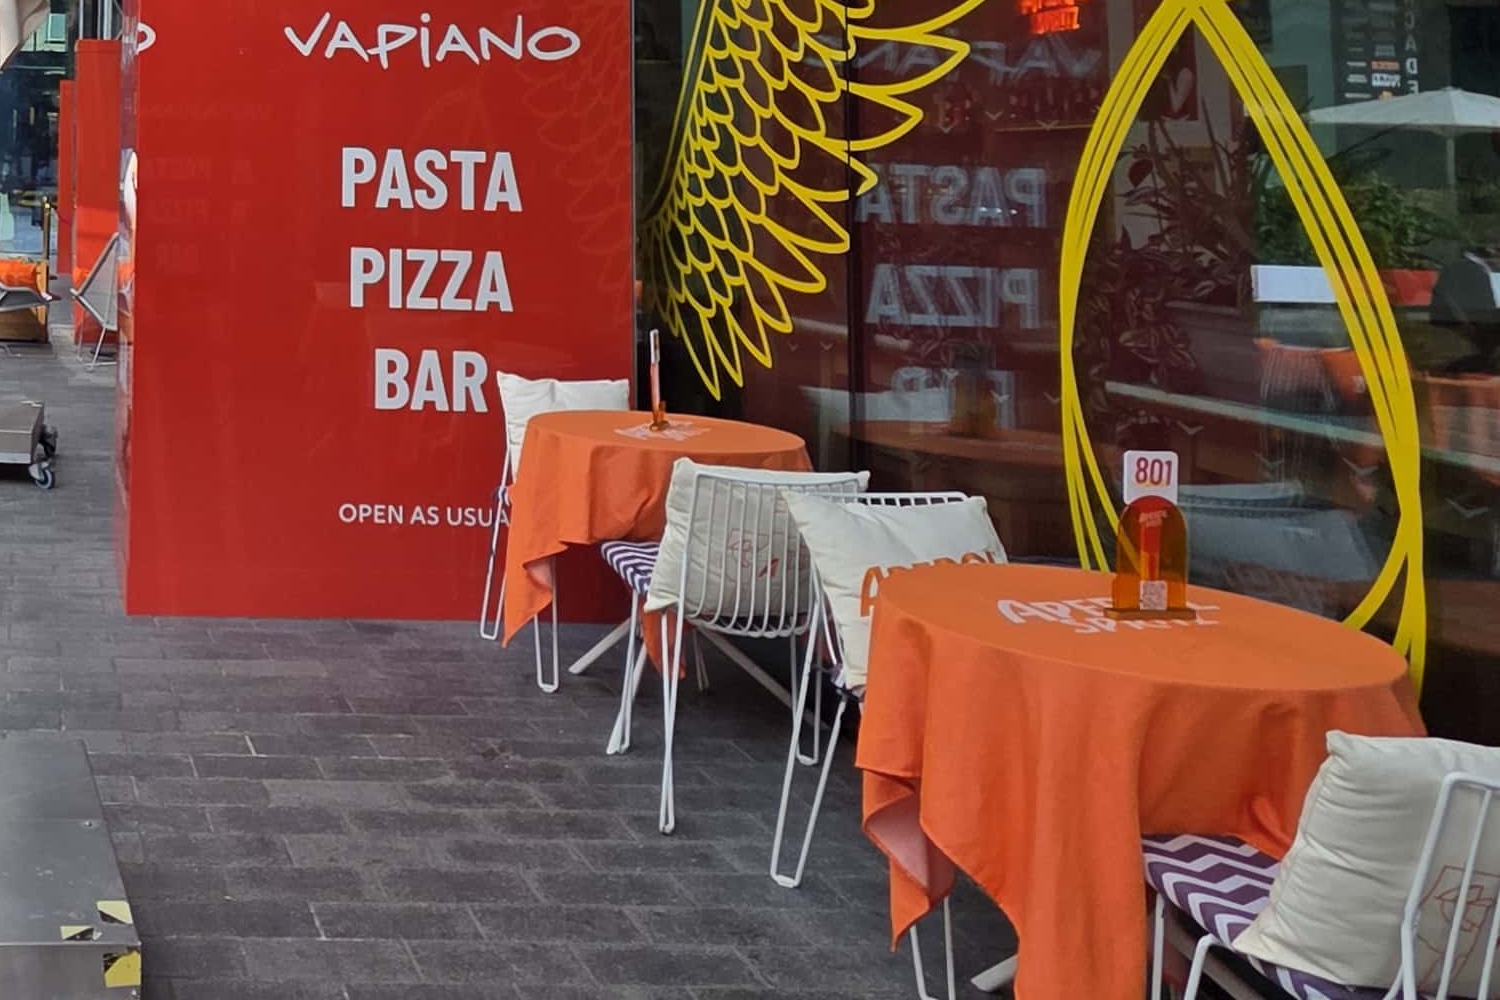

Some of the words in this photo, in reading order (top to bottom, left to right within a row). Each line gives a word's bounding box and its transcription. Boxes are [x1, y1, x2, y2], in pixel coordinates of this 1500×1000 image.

[284, 12, 581, 69] VAPIANO
[341, 146, 523, 212] PASTA
[350, 246, 514, 312] PIZZA
[374, 348, 488, 413] BAR
[1134, 456, 1172, 486] 801
[339, 503, 403, 524] OPEN
[410, 505, 440, 525] AS
